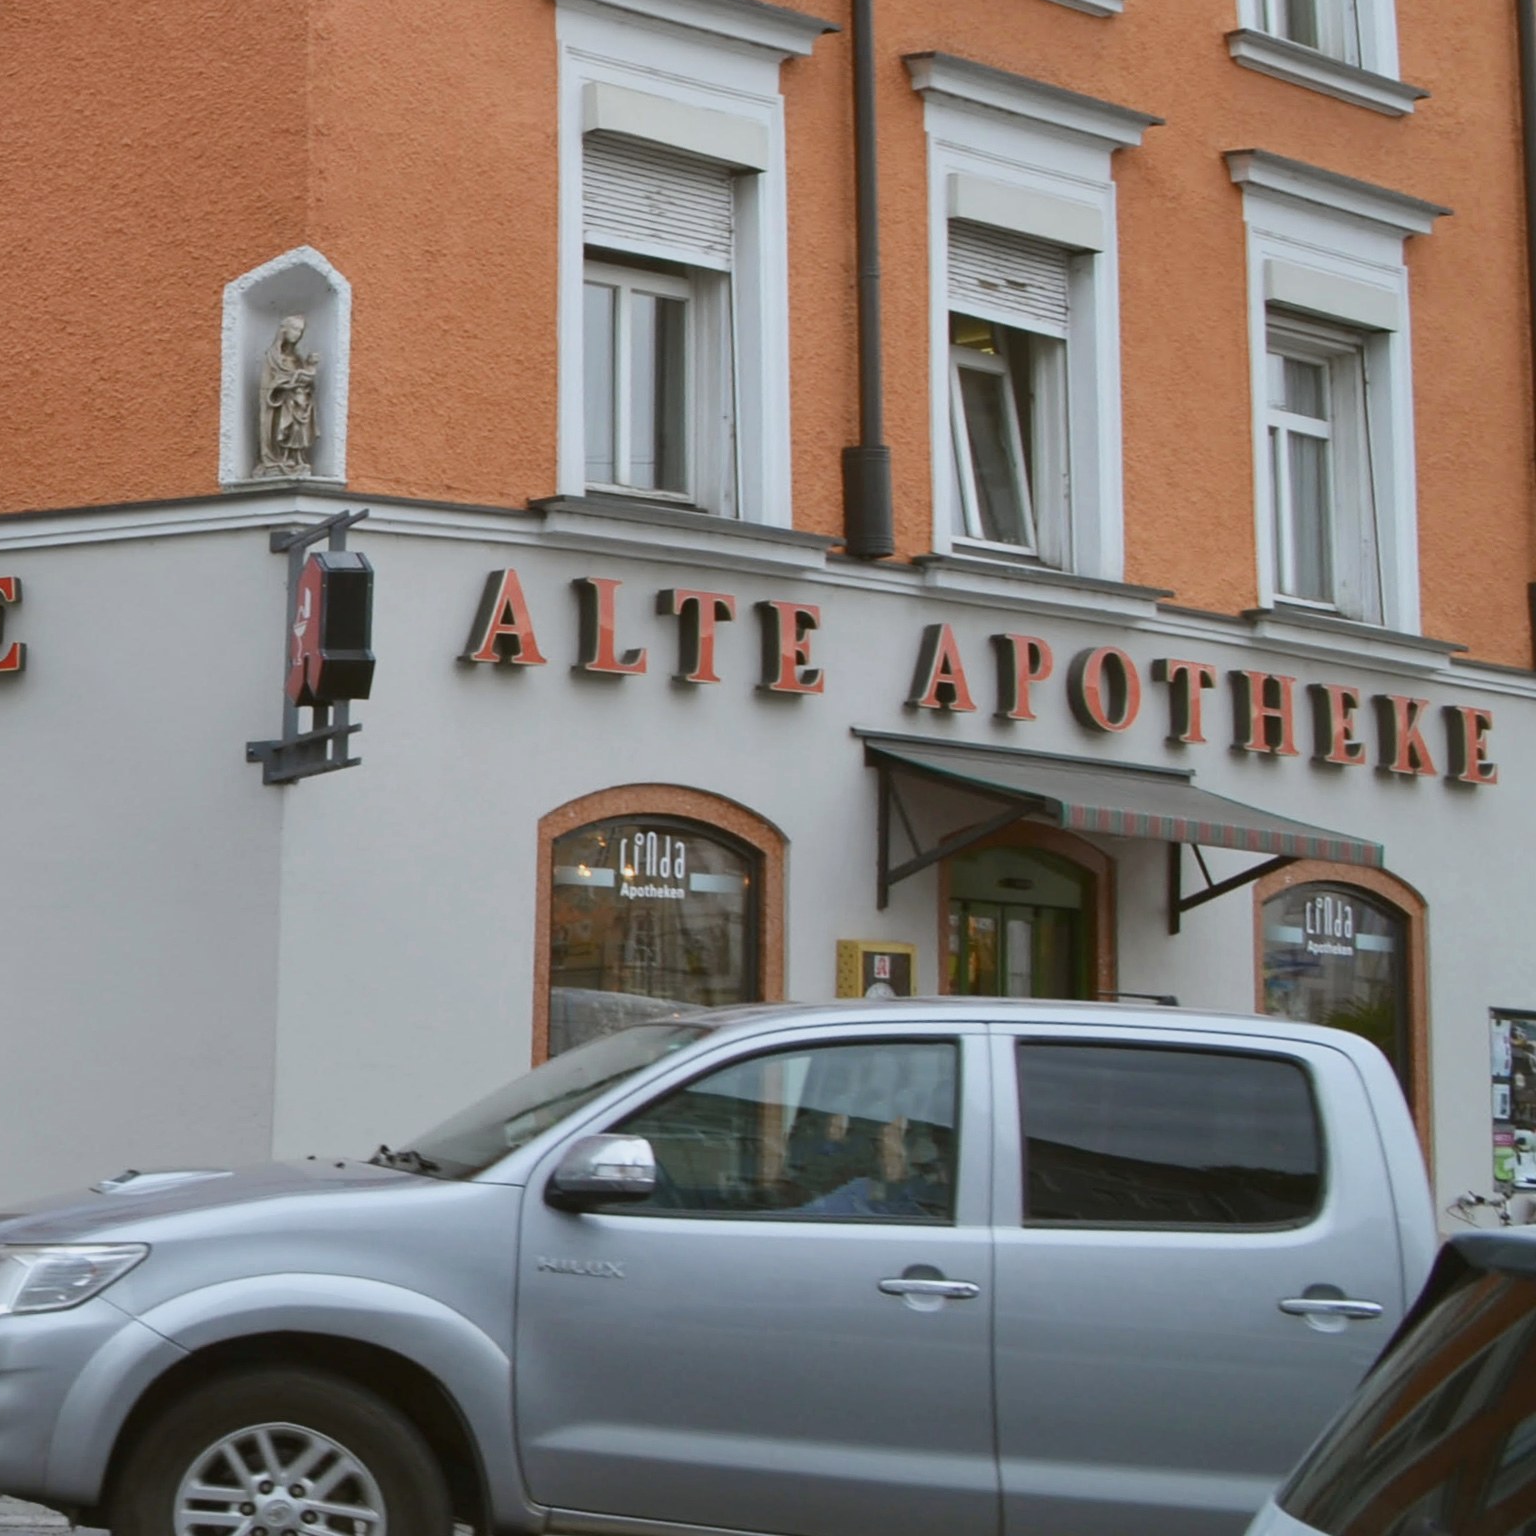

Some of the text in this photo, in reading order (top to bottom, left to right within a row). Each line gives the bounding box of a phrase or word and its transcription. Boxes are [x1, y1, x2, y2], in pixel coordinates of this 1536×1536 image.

[456, 567, 1500, 786] ALTE APOTHEKE
[620, 882, 685, 900] Apotheken
